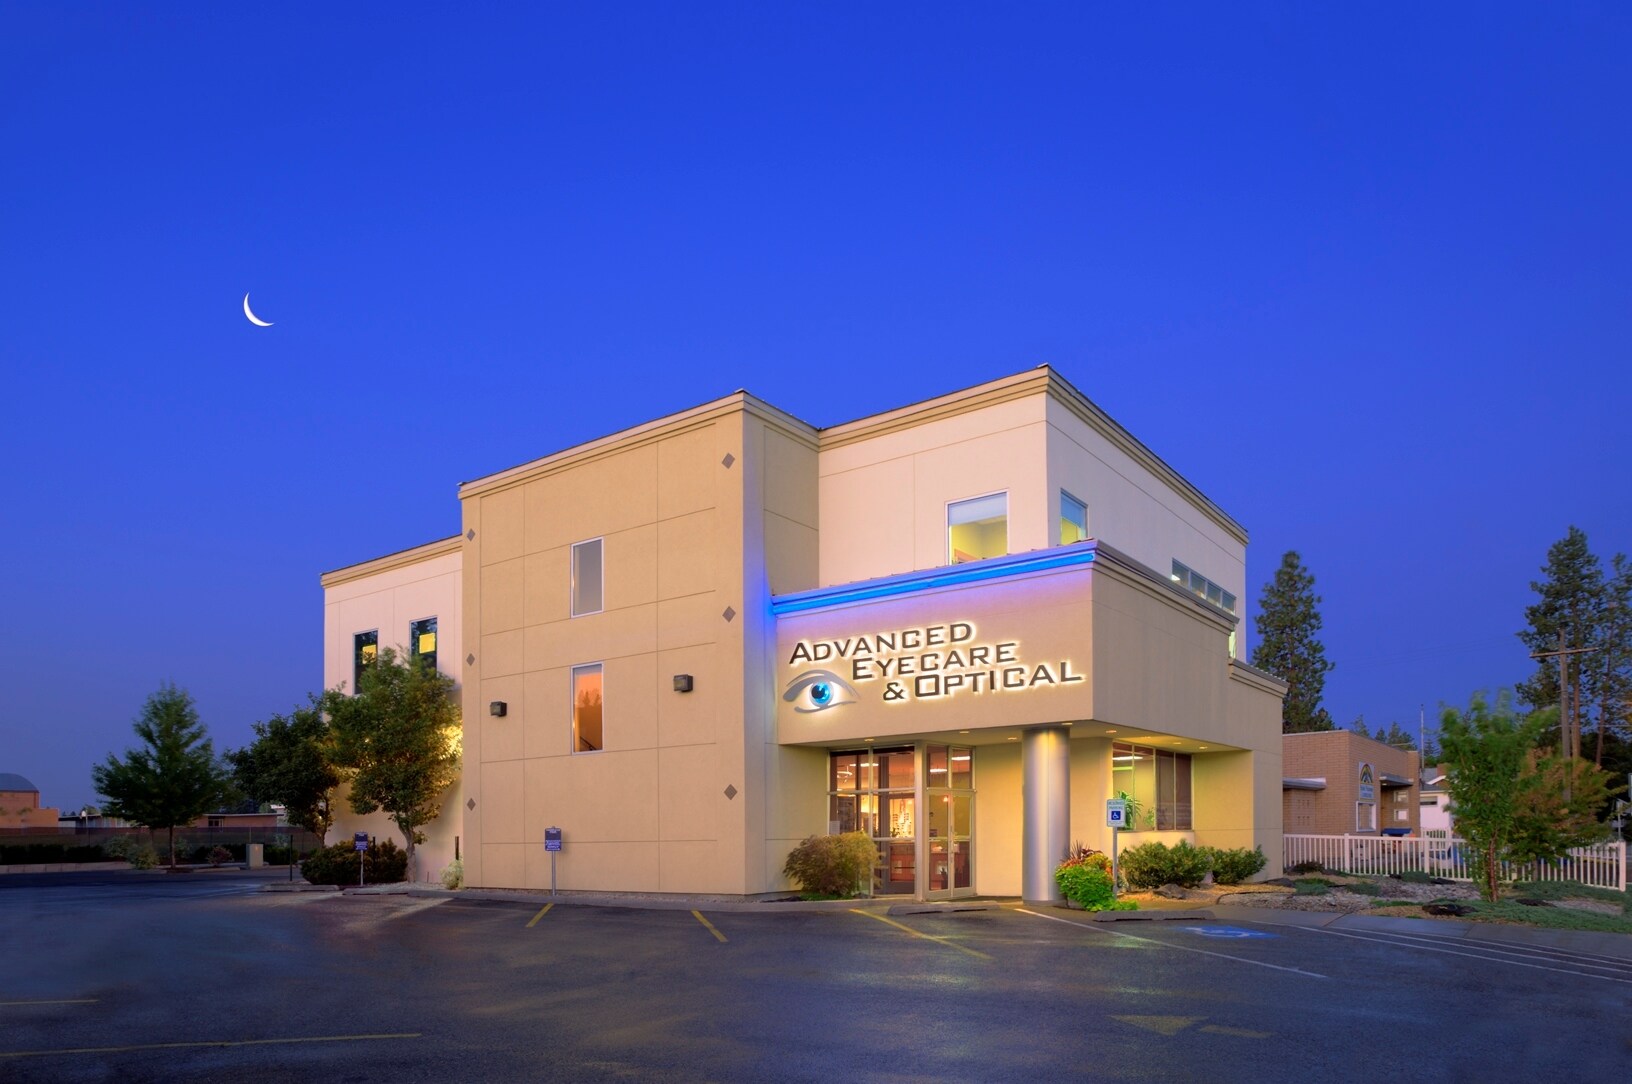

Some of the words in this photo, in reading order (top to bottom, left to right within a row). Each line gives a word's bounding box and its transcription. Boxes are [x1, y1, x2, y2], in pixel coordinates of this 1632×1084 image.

[789, 622, 973, 664] ADVANCED
[852, 642, 1017, 680] EYECARE
[883, 682, 906, 701] &
[914, 662, 1083, 697] OPTICAL
